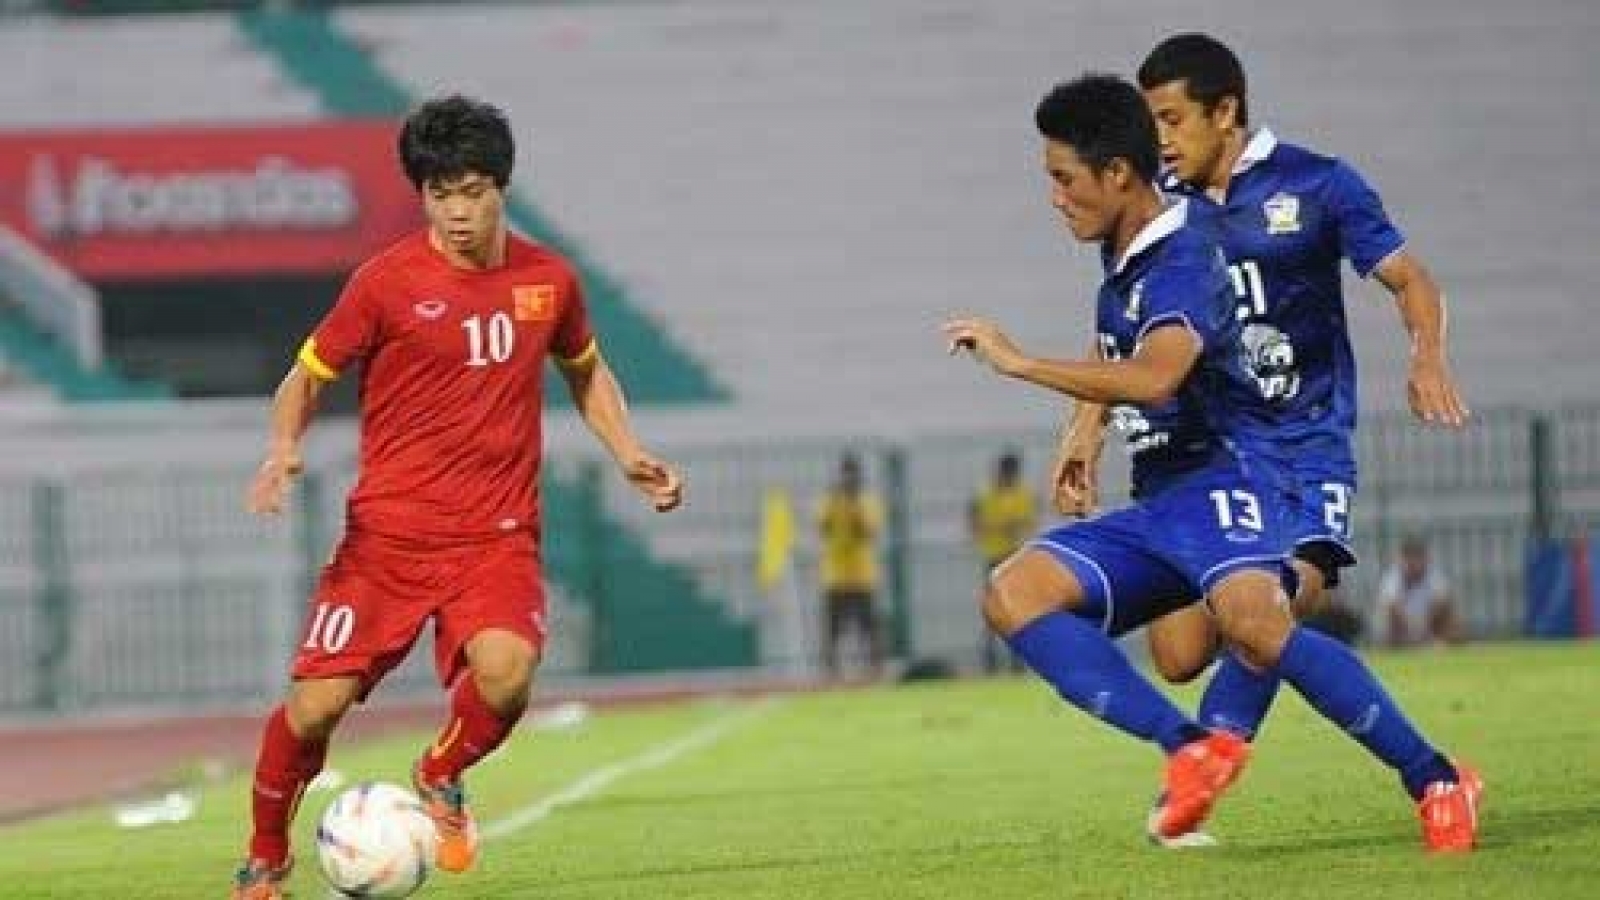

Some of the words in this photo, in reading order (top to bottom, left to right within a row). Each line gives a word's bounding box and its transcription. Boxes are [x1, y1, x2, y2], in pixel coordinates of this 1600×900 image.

[461, 311, 515, 366] 10
[1209, 489, 1264, 532] 13
[303, 602, 355, 654] 10
